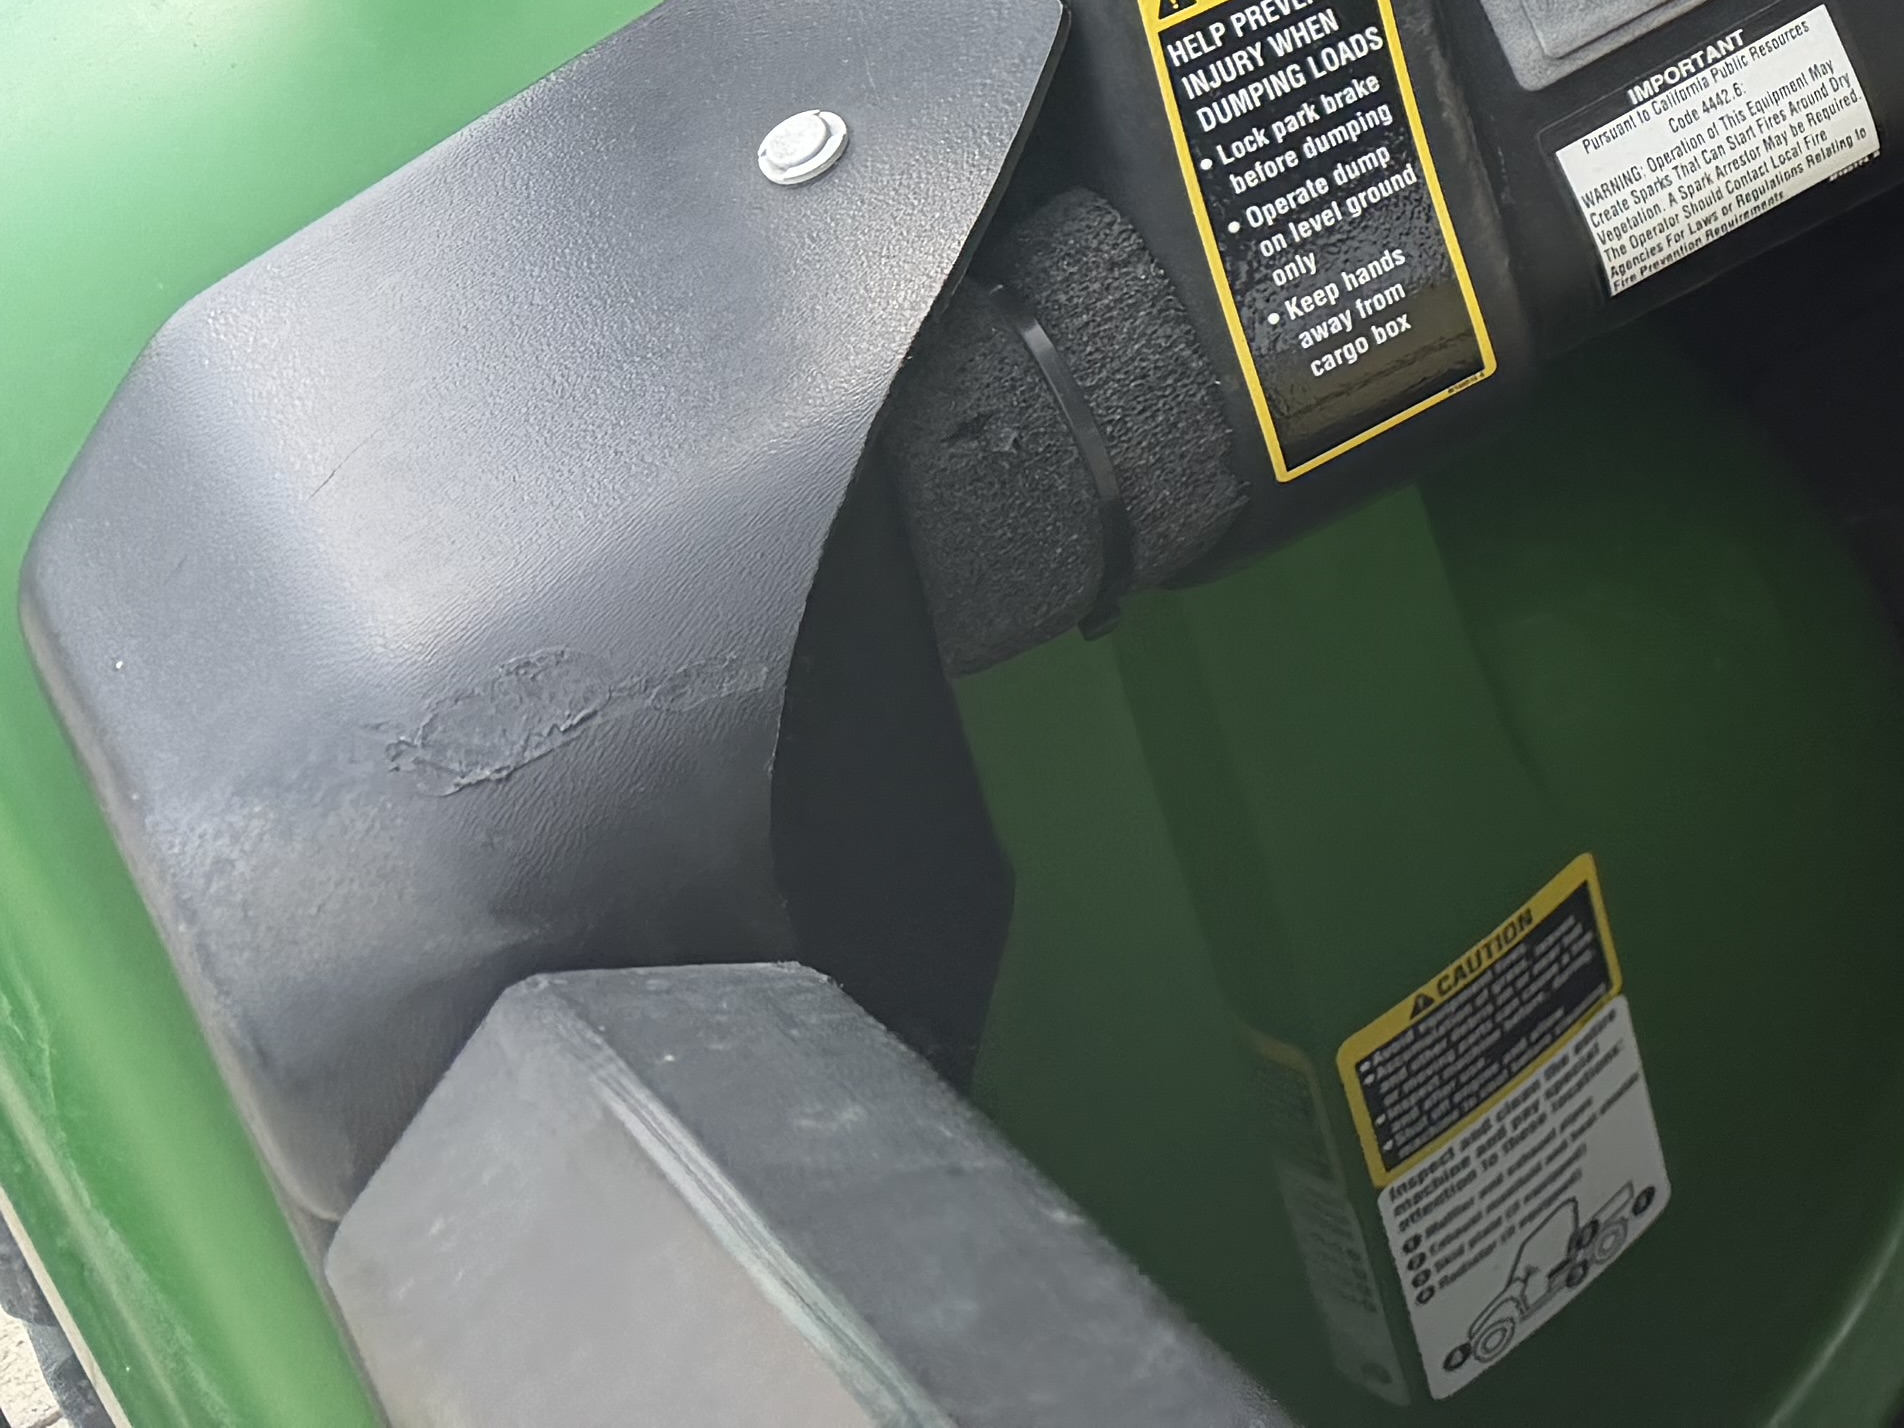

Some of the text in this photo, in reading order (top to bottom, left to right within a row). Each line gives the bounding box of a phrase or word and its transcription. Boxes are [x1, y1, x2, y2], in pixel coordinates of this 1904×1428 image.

[1167, 20, 1230, 68] HELP
[1182, 7, 1339, 100] INJURY WHEN
[1196, 25, 1384, 132] DUMPING LOADS
[1581, 19, 1810, 154] Pursuant to California Public Resources
[1627, 28, 1747, 105] IMPORTANT
[1216, 71, 1380, 165] Lock park brake
[1229, 101, 1391, 194] before dumping
[1581, 57, 1834, 209] WARNING: Operation of This Equipment May
[1589, 71, 1851, 228] Create Sparks That Can Start Fires Around Dry
[1666, 191, 1677, 207] A
[1677, 170, 1713, 201] Spark
[1713, 143, 1762, 181] Arrestor
[1762, 128, 1788, 153] May
[1789, 118, 1805, 137] be
[1667, 105, 1700, 134] Code
[1245, 143, 1391, 228] Operate dump
[1258, 162, 1417, 258] on level ground
[1604, 240, 1627, 263] The
[1628, 210, 1681, 249] Operator
[1681, 186, 1724, 219] Should
[1724, 160, 1770, 195] Contact
[1769, 142, 1802, 169] Local
[1803, 128, 1827, 150] Fire
[1609, 241, 1663, 279] Agencies
[1665, 228, 1686, 247] For
[1687, 210, 1719, 235] Laws
[1720, 203, 1734, 216] or
[1735, 161, 1804, 208] Regulations
[1805, 133, 1853, 168] Relating
[1854, 125, 1867, 141] to
[1271, 248, 1317, 287] only
[1284, 244, 1406, 321] Keep hands
[1296, 280, 1405, 349] away from
[1308, 310, 1411, 377] cargo box
[1436, 906, 1532, 998] CAUTION
